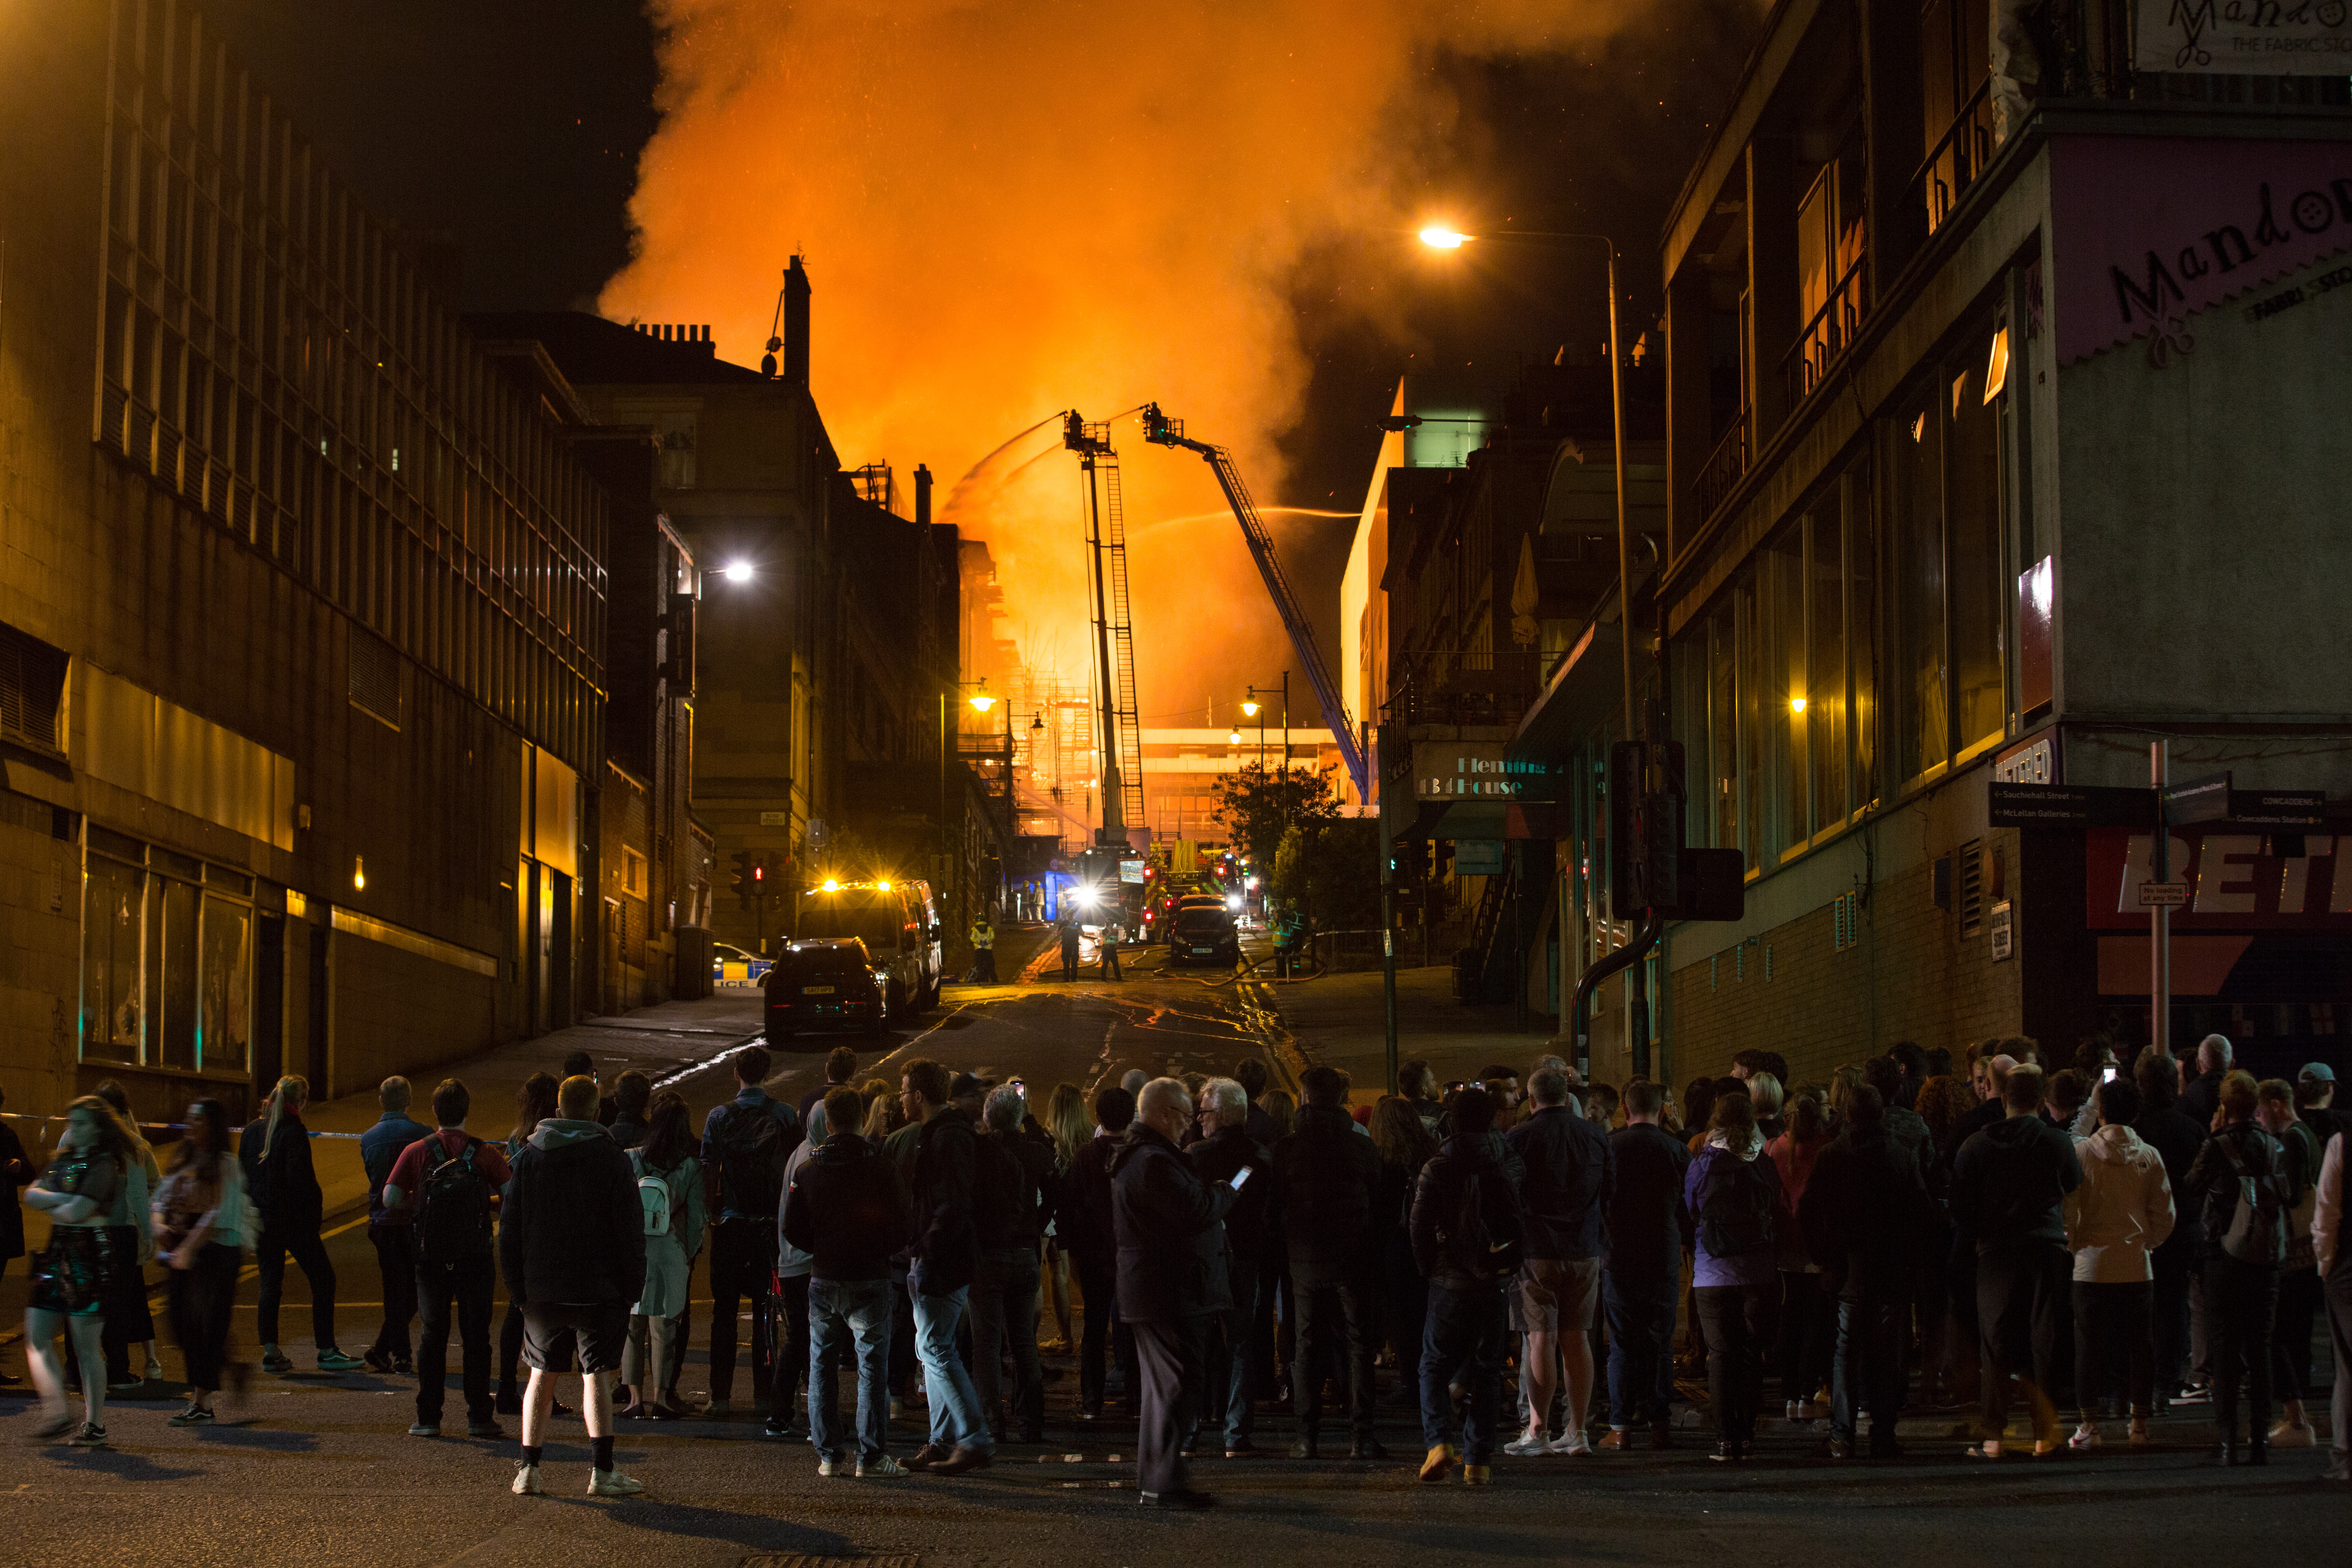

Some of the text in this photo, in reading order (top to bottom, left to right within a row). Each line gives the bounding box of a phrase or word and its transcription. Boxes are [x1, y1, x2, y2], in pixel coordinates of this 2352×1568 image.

[2232, 37, 2261, 51] THE
[2266, 37, 2319, 52] FABRIC
[1457, 779, 1523, 794] House
[2003, 791, 2045, 799] Sauchiehall
[2047, 791, 2069, 800] Street
[2262, 797, 2314, 806] COWCADDENS
[2038, 810, 2070, 818] Galleries
[2236, 815, 2280, 823] Cowcaddens
